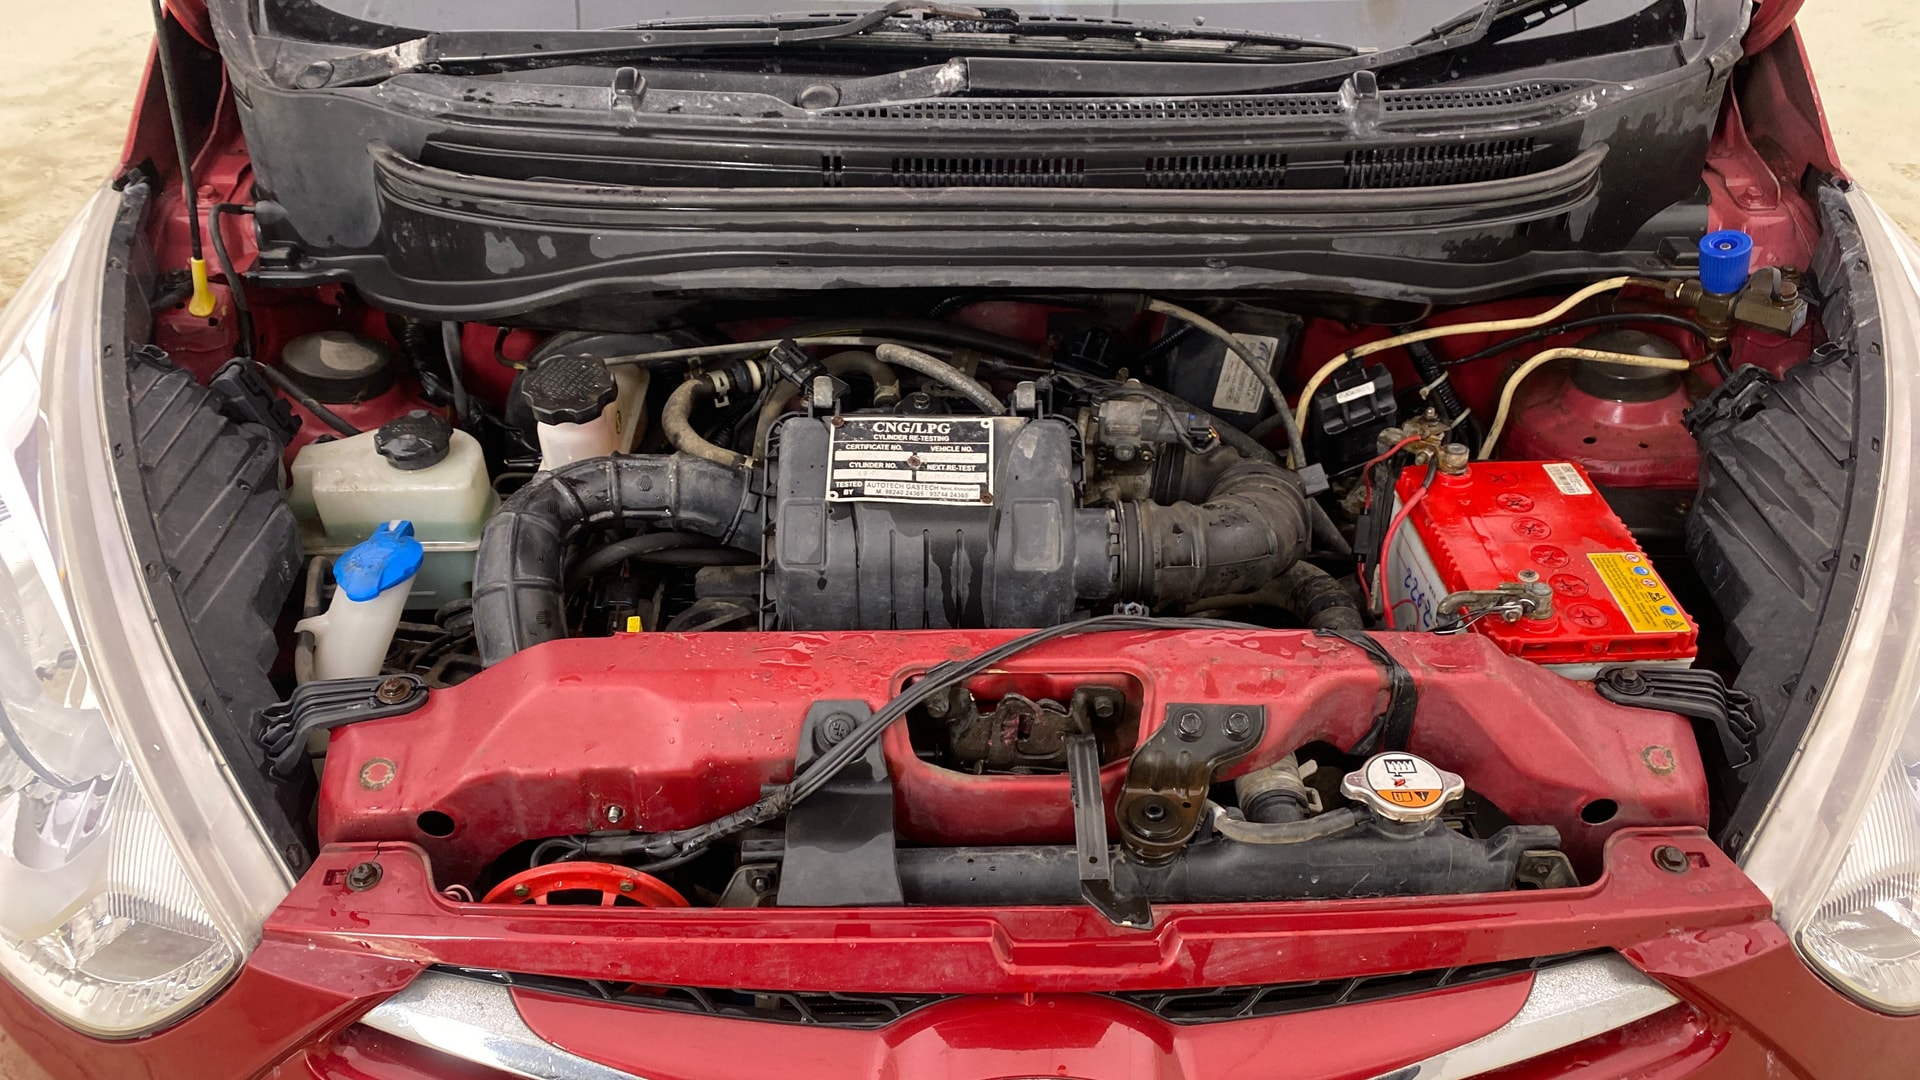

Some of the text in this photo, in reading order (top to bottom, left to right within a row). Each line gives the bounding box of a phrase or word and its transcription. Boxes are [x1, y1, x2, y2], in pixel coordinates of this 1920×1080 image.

[872, 421, 951, 434] CNG/LPG
[909, 434, 950, 442] RE-TESTING
[845, 443, 889, 451] CERTIFICATE
[848, 461, 884, 469] CYLINDER
[946, 464, 976, 472] RE-TEST
[905, 483, 939, 491] GASTECH
[843, 488, 854, 496] BY
